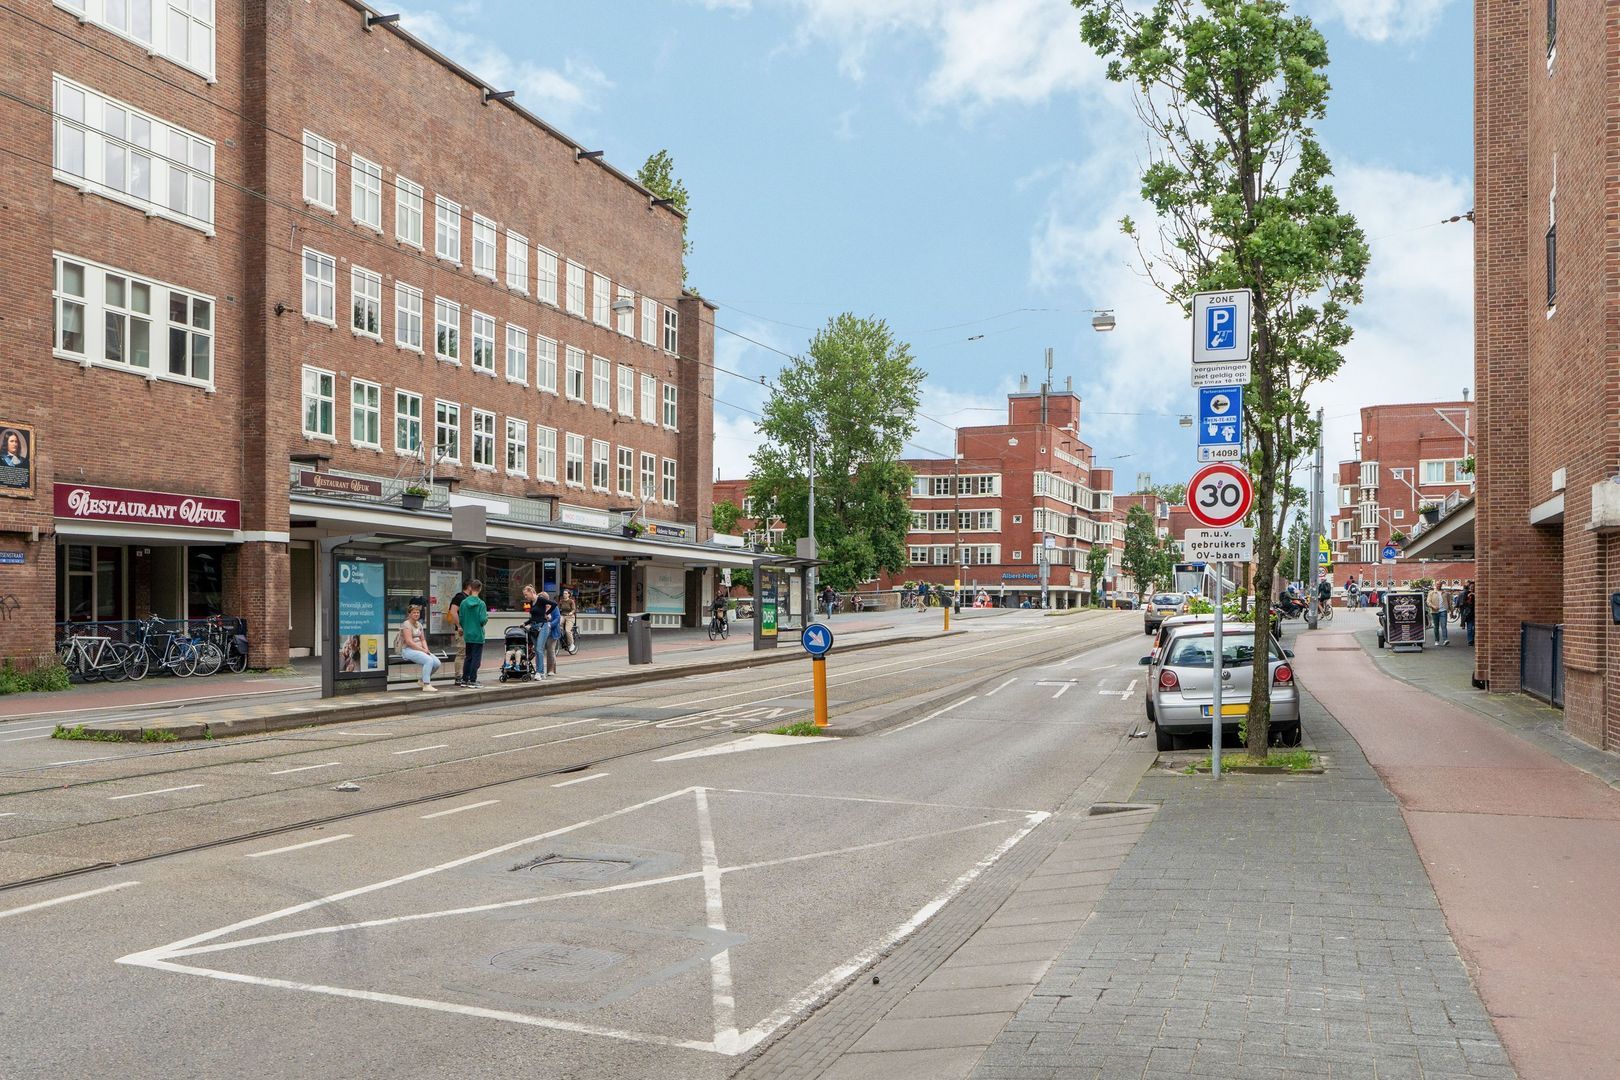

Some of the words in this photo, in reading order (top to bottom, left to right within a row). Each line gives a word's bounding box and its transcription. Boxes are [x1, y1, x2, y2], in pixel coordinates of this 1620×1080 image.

[1209, 295, 1234, 304] ZONE
[1213, 310, 1229, 332] P
[1211, 449, 1238, 457] 14098
[313, 475, 350, 489] RESTAURANT
[350, 479, 370, 492] UFUK
[1200, 484, 1240, 507] 30
[67, 489, 177, 519] RESTAURANT
[179, 499, 226, 523] UFUK
[1191, 541, 1246, 551] gebruikers
[1196, 551, 1240, 559] OV-baan
[763, 611, 775, 623] D66
